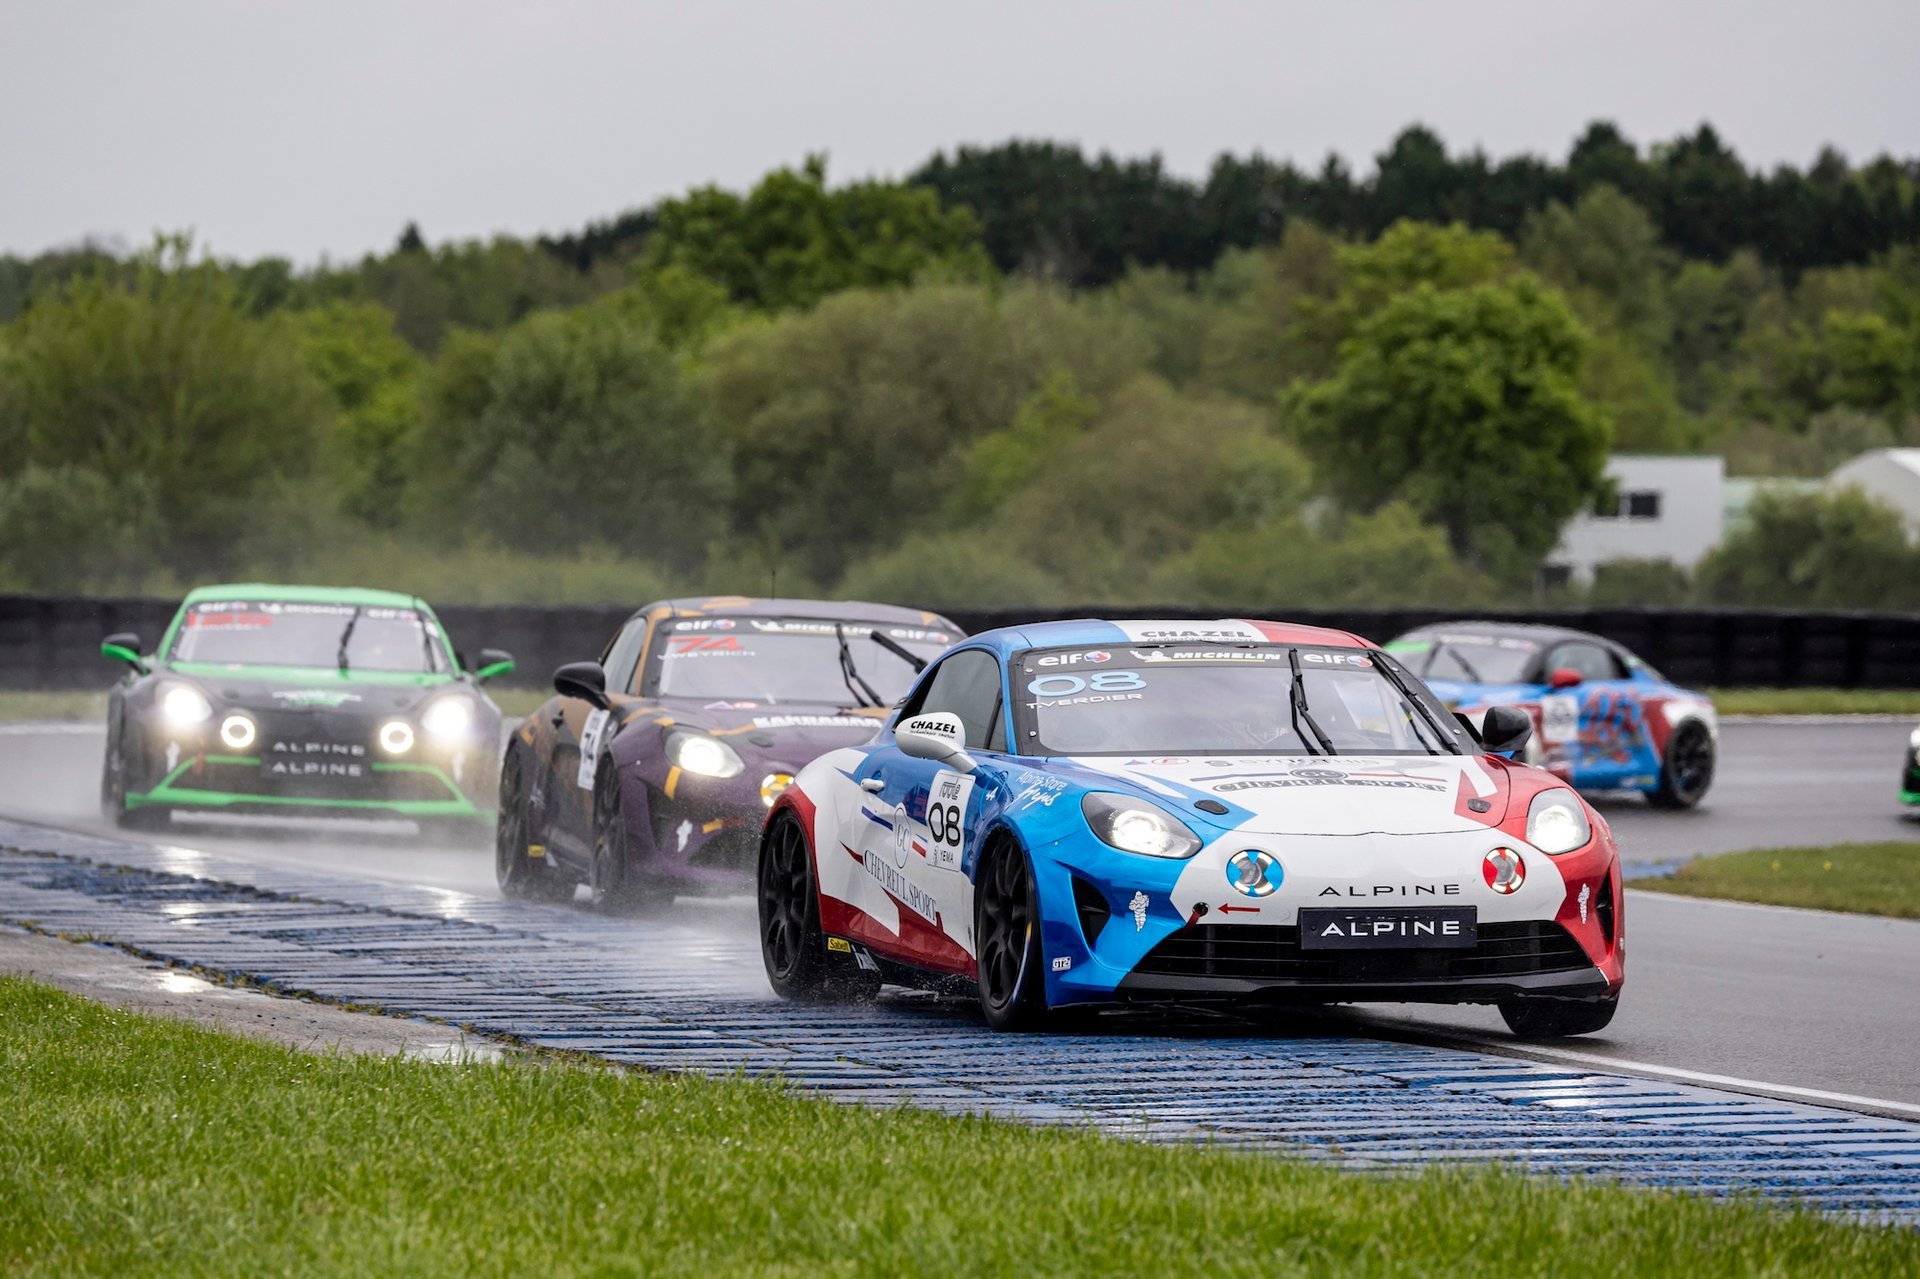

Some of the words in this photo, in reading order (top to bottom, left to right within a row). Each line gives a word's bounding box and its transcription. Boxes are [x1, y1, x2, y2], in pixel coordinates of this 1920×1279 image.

[675, 619, 713, 631] elf
[1140, 630, 1252, 638] CHAZEL
[670, 635, 746, 653] 74
[1037, 653, 1083, 666] elf
[1173, 652, 1281, 660] MICHELIN
[1303, 653, 1346, 664] elf
[1027, 671, 1147, 697] 08
[910, 720, 956, 734] CHAZEL
[272, 741, 365, 757] ALPINE
[271, 761, 362, 777] ALPINE
[928, 801, 961, 847] 08
[864, 849, 909, 902] CHEVREUL
[908, 882, 937, 921] SPORT
[1318, 883, 1461, 897] ALPINE
[1320, 920, 1461, 937] ALPINE
